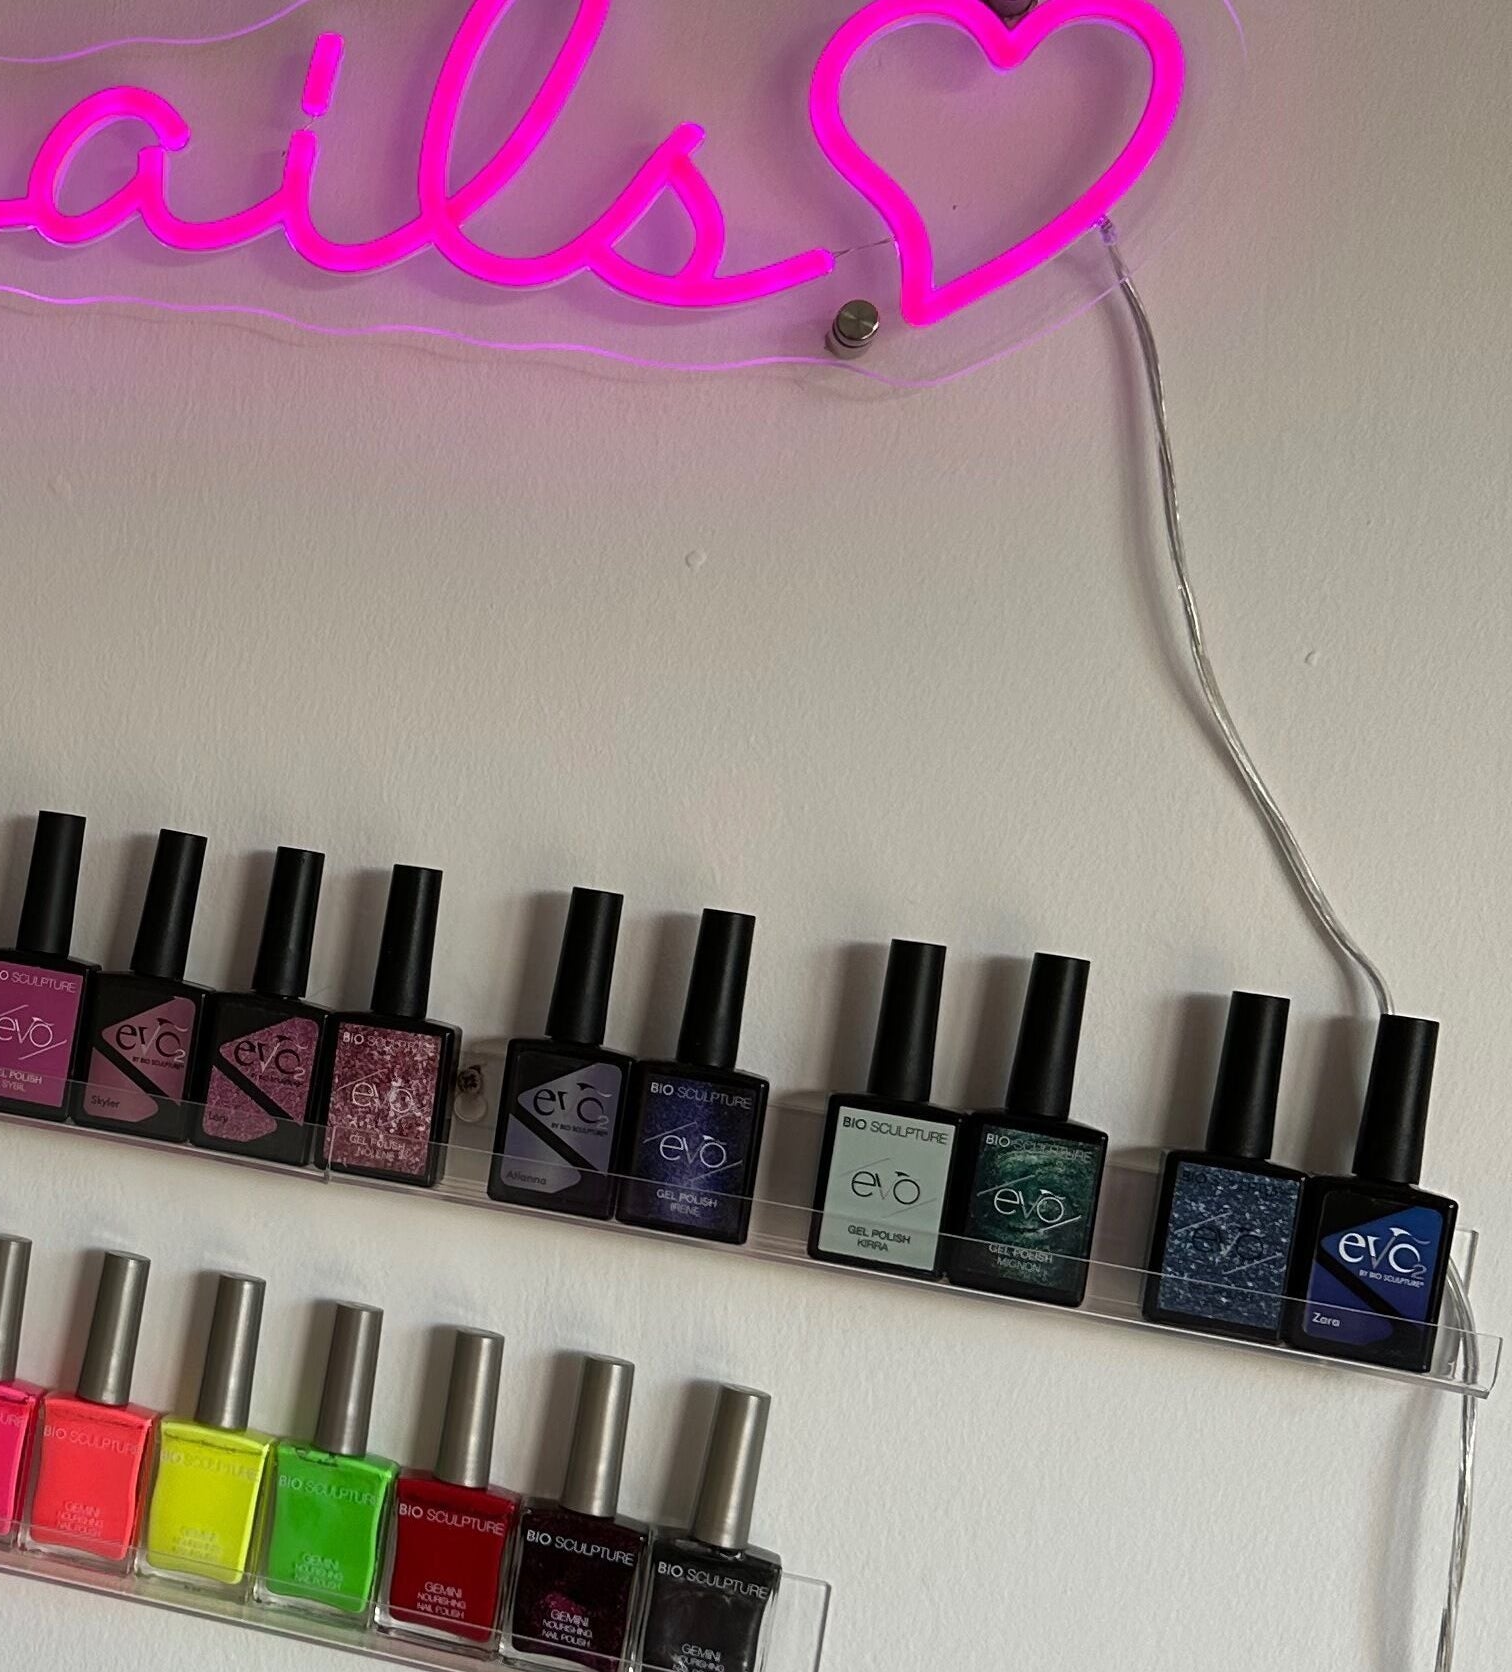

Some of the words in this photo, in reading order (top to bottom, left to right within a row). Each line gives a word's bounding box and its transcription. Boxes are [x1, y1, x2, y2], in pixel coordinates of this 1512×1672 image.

[11, 971, 77, 993] SCULPTURE
[343, 1031, 365, 1045] BIO
[9, 1069, 43, 1085] POLISH
[90, 1095, 120, 1109] Skyler
[650, 1081, 674, 1096] BIO
[677, 1086, 752, 1110] SCULPTURE
[843, 1116, 867, 1130] BIO
[870, 1121, 949, 1145] SCULPTURE
[986, 1133, 1010, 1147] BIO
[656, 1188, 677, 1201] GEL
[679, 1192, 719, 1208] POLISH
[670, 1202, 700, 1216] IRENE
[847, 1224, 869, 1238] GEL
[871, 1229, 911, 1244] POLISH
[857, 1237, 889, 1252] KIRRA
[988, 1242, 1012, 1255] GEL
[1013, 1246, 1053, 1264] POLISH
[997, 1256, 1041, 1273] MIGNON
[1359, 1268, 1368, 1277] BY
[1369, 1271, 1383, 1280] BIO
[1311, 1311, 1342, 1328] Zara
[43, 1425, 67, 1440] BIO
[70, 1430, 141, 1456] SCULPTURE
[279, 1474, 302, 1490] BIO
[64, 1500, 101, 1517] GEMINI
[399, 1502, 424, 1519] BIO
[426, 1508, 505, 1537] SCULPTURE
[526, 1529, 552, 1546] BIO
[554, 1536, 635, 1567] SCULPTURE
[301, 1553, 339, 1570] GEMINI
[424, 1581, 463, 1599] GEMINI
[657, 1561, 684, 1578] BIO
[686, 1568, 770, 1600] SCULPTURE
[417, 1591, 467, 1610] NOURISHING
[416, 1602, 433, 1613] NAIL
[435, 1605, 465, 1619] POLISH
[550, 1609, 589, 1628] GEMINI
[542, 1618, 593, 1639] NOURISHING
[541, 1629, 559, 1641] NAIL
[560, 1632, 591, 1648] POLISH
[681, 1643, 722, 1663] GEMINI
